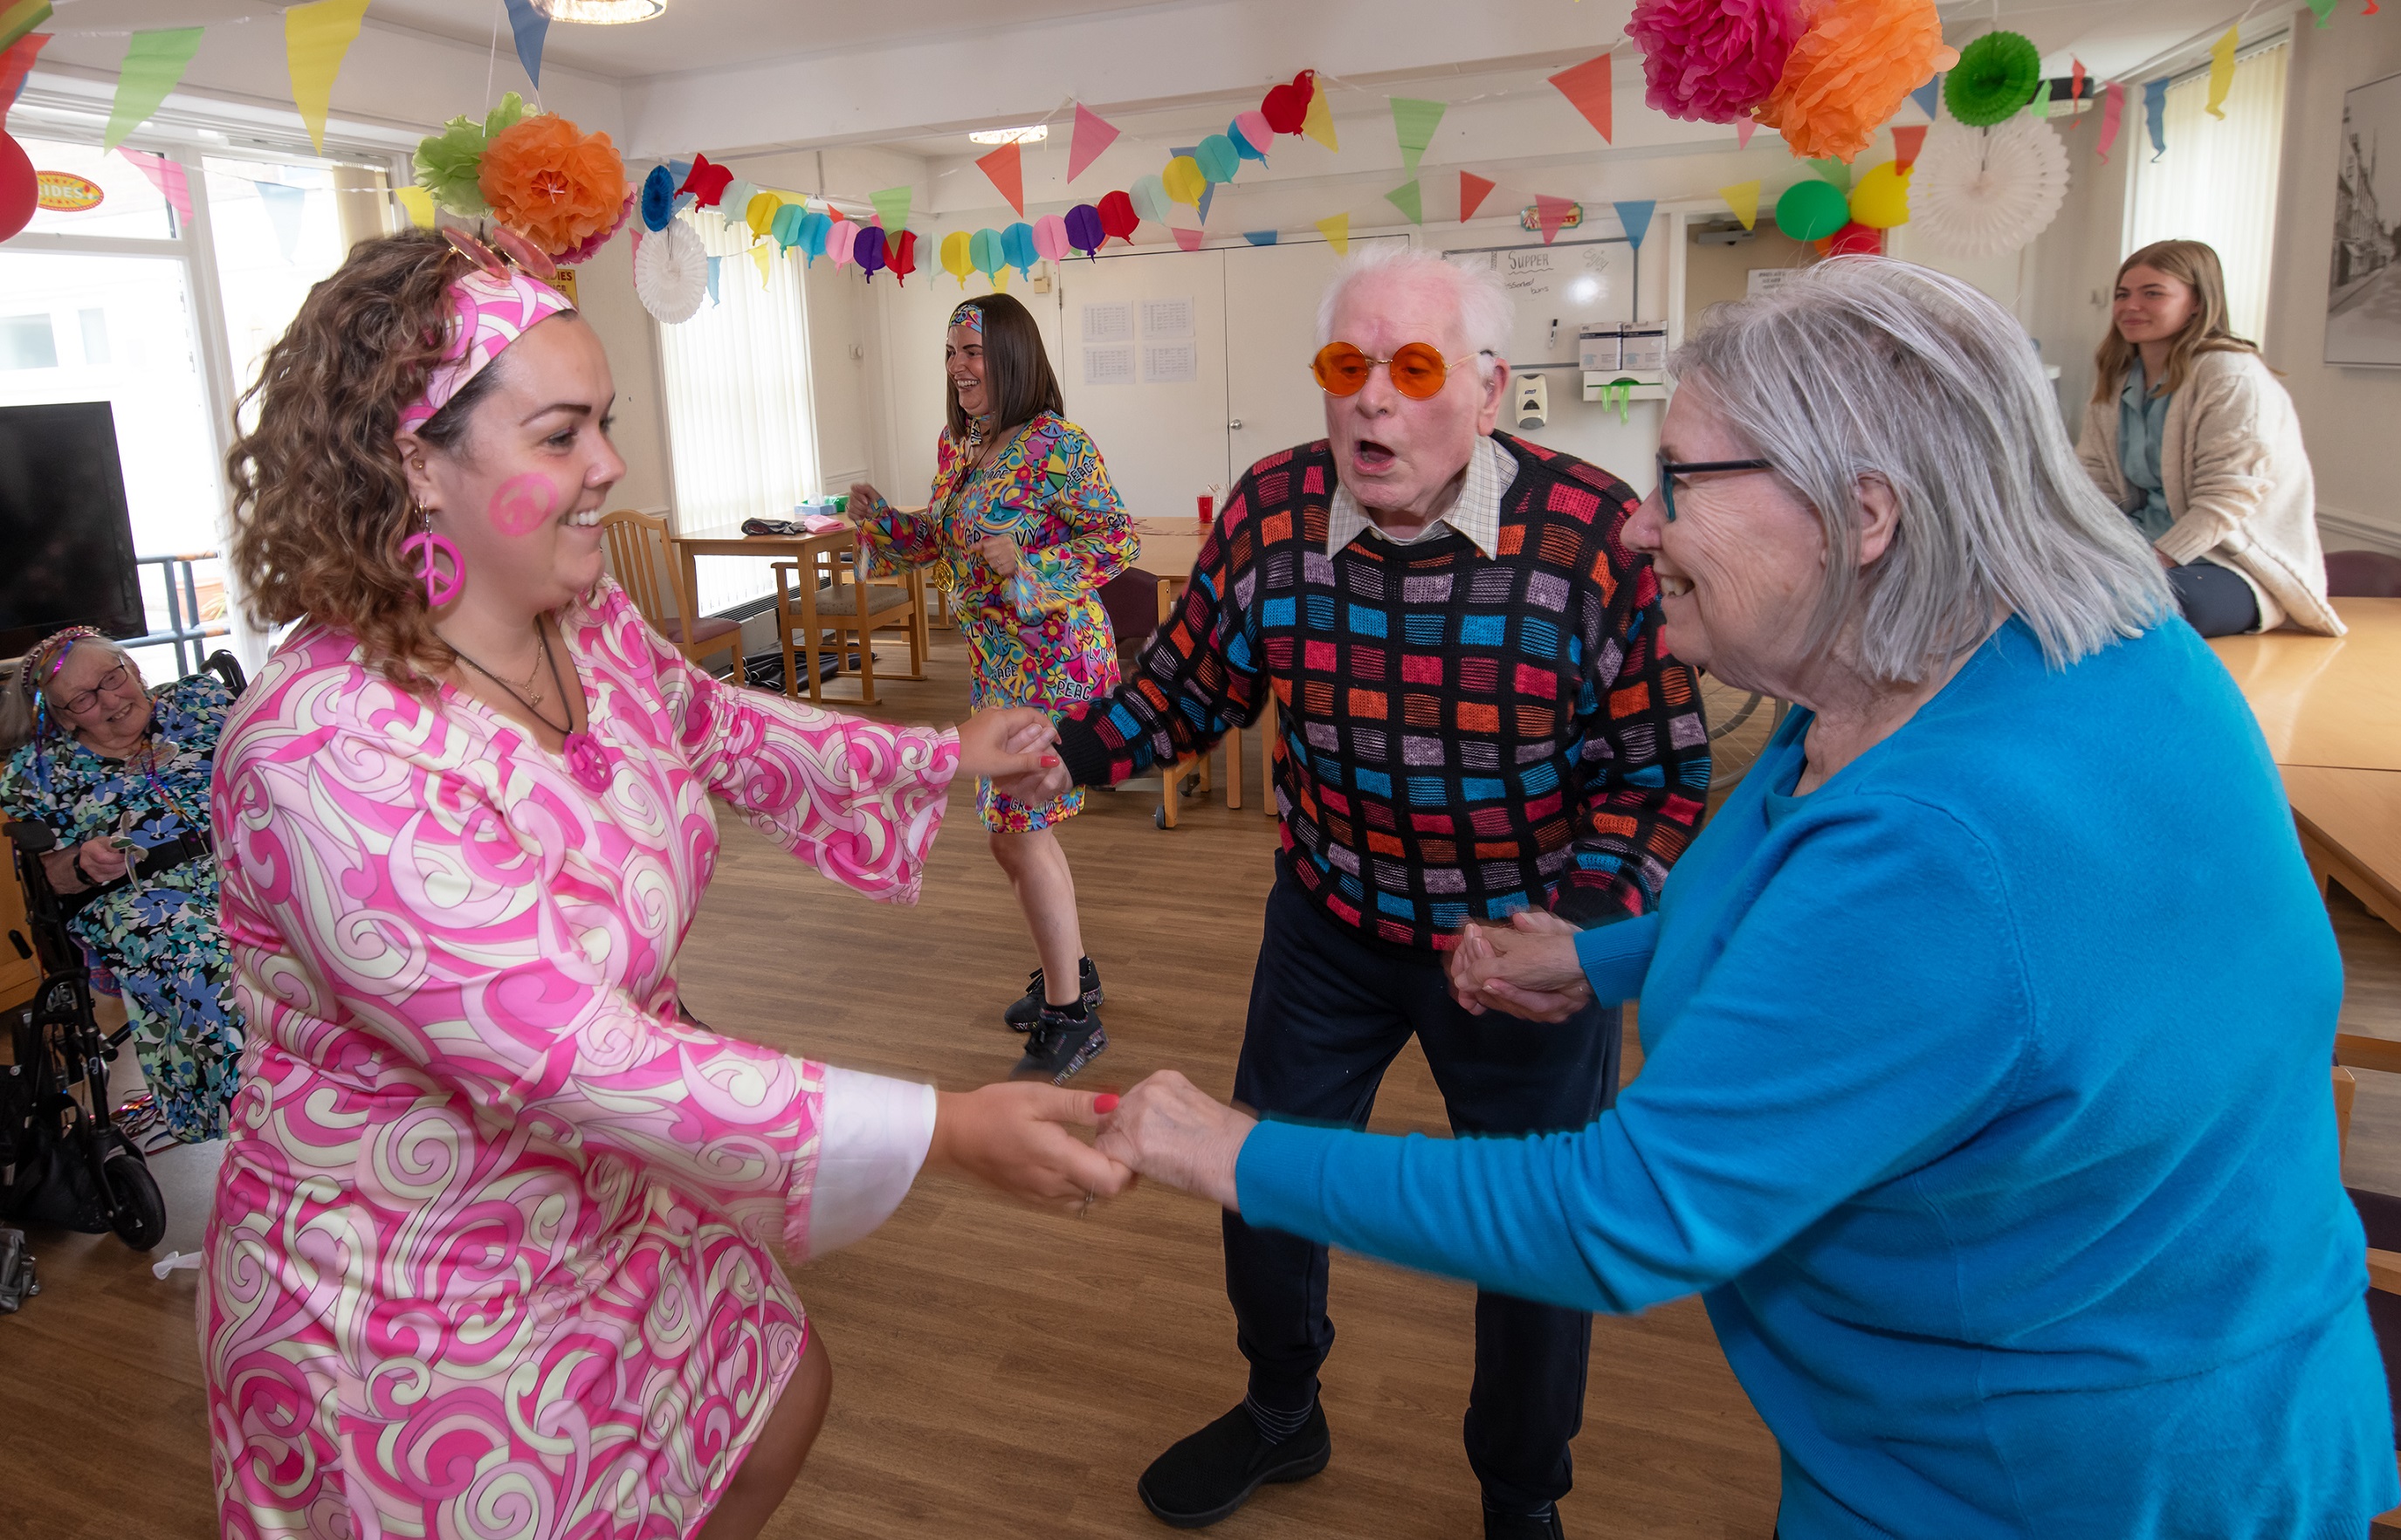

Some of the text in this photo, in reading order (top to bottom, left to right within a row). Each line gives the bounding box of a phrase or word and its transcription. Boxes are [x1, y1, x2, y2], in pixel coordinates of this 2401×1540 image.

[1508, 251, 1549, 270] SUPPER
[1506, 278, 1534, 289] ssorted
[1066, 458, 1097, 486] PEACE
[1056, 680, 1092, 700] PEAC
